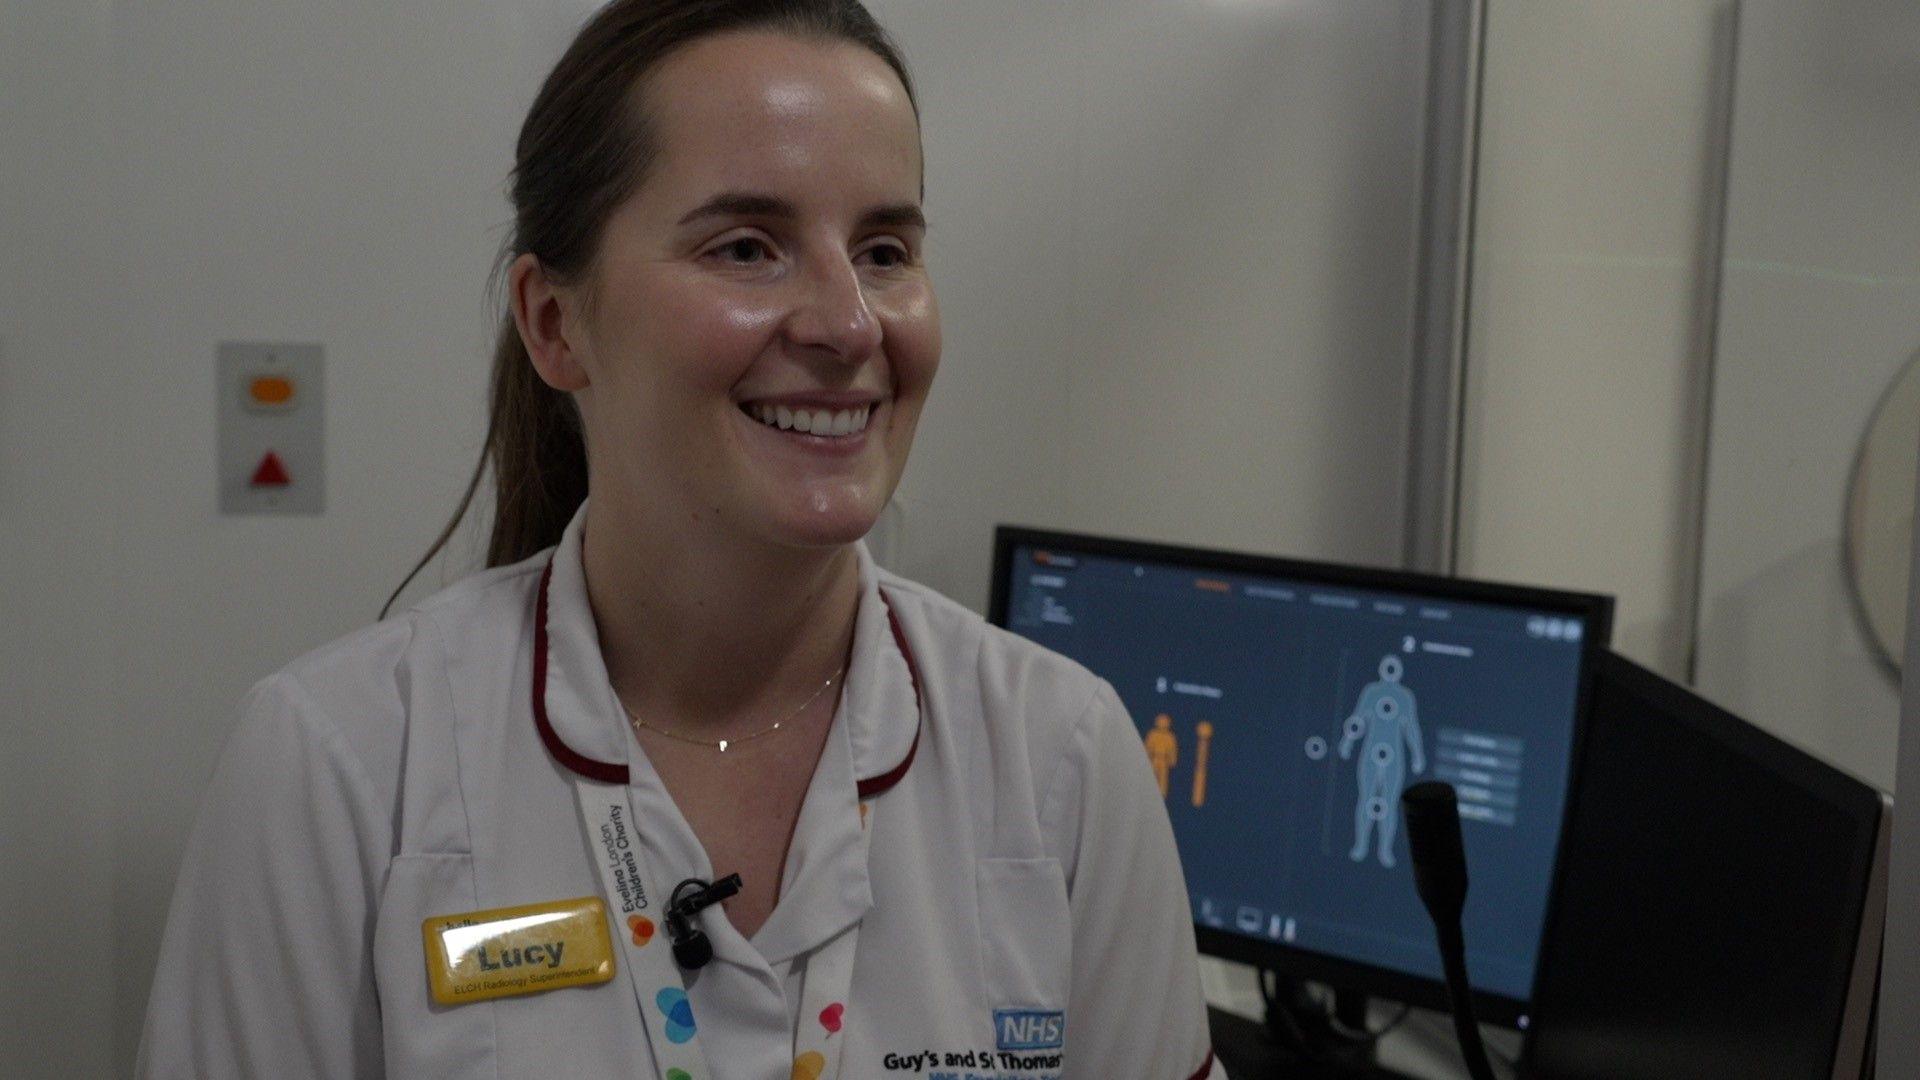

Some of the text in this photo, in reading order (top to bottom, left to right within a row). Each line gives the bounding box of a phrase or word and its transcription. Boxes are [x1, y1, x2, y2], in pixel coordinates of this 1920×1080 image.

[600, 824, 635, 913] Evelina London
[610, 805, 648, 909] Children's Charity
[478, 941, 565, 972] Lucy
[483, 977, 528, 991] Radiology
[529, 966, 597, 983] Superintendent
[1003, 1016, 1061, 1043] NHS
[884, 1050, 939, 1073] Guy's
[945, 1050, 976, 1068] and
